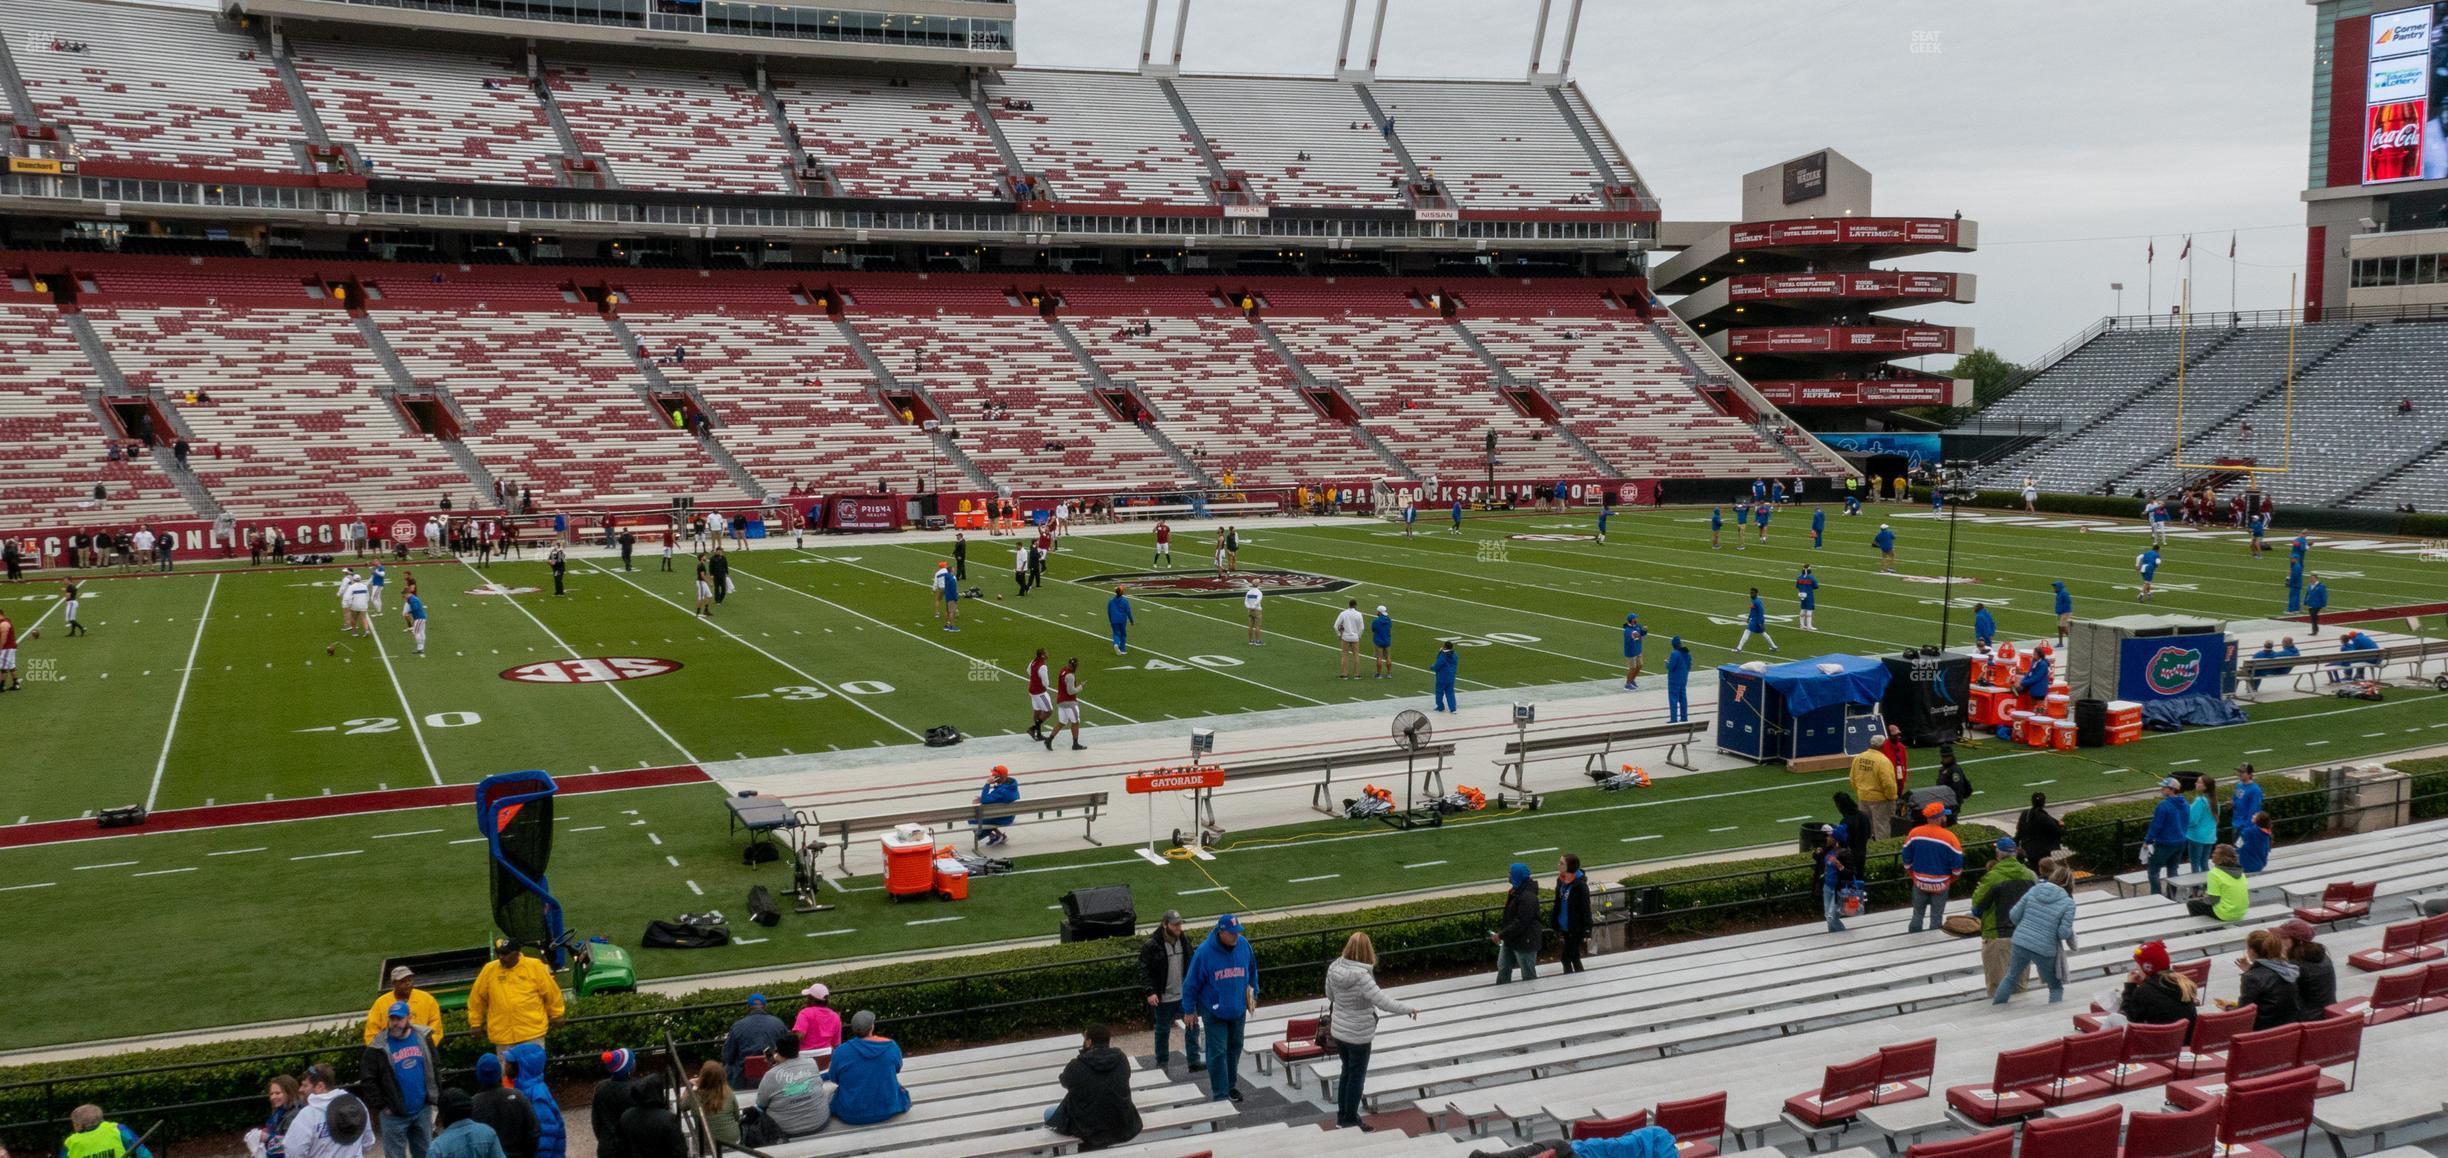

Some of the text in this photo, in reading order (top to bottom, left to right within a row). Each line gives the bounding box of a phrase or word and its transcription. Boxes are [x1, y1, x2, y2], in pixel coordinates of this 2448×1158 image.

[2394, 23, 2427, 34] Corner
[2392, 31, 2424, 42] Pantry
[1434, 632, 1542, 647] 50
[1144, 655, 1245, 671] 40
[773, 680, 896, 700] 30
[342, 711, 482, 735] 20
[1151, 775, 1204, 788] GATORADE
[1215, 967, 1245, 981] FLORIDA
